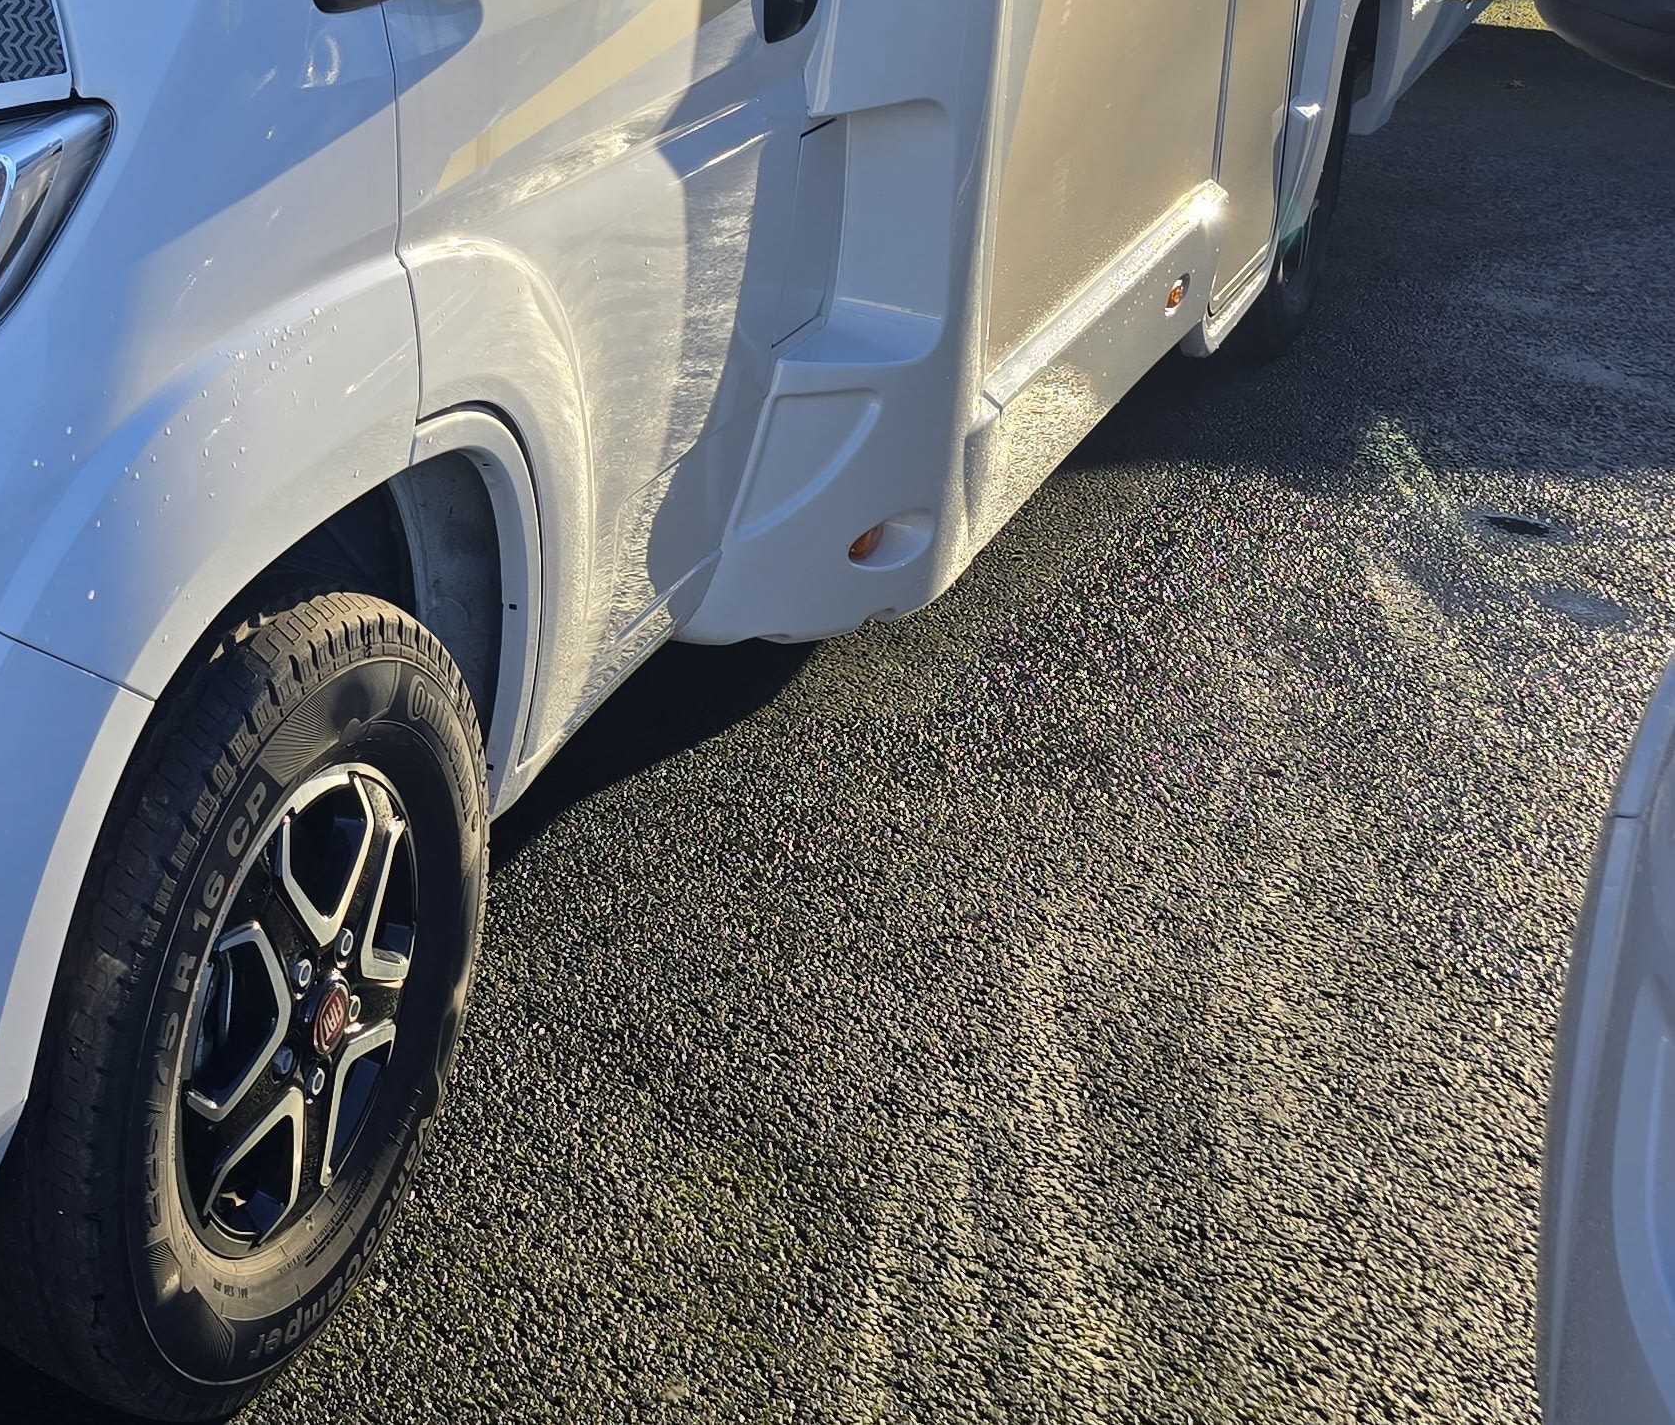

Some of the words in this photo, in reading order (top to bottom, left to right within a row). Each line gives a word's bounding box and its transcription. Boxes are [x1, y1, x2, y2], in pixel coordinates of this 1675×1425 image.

[192, 870, 226, 932] 16
[227, 781, 267, 858] CP
[323, 995, 345, 1042] FIAT
